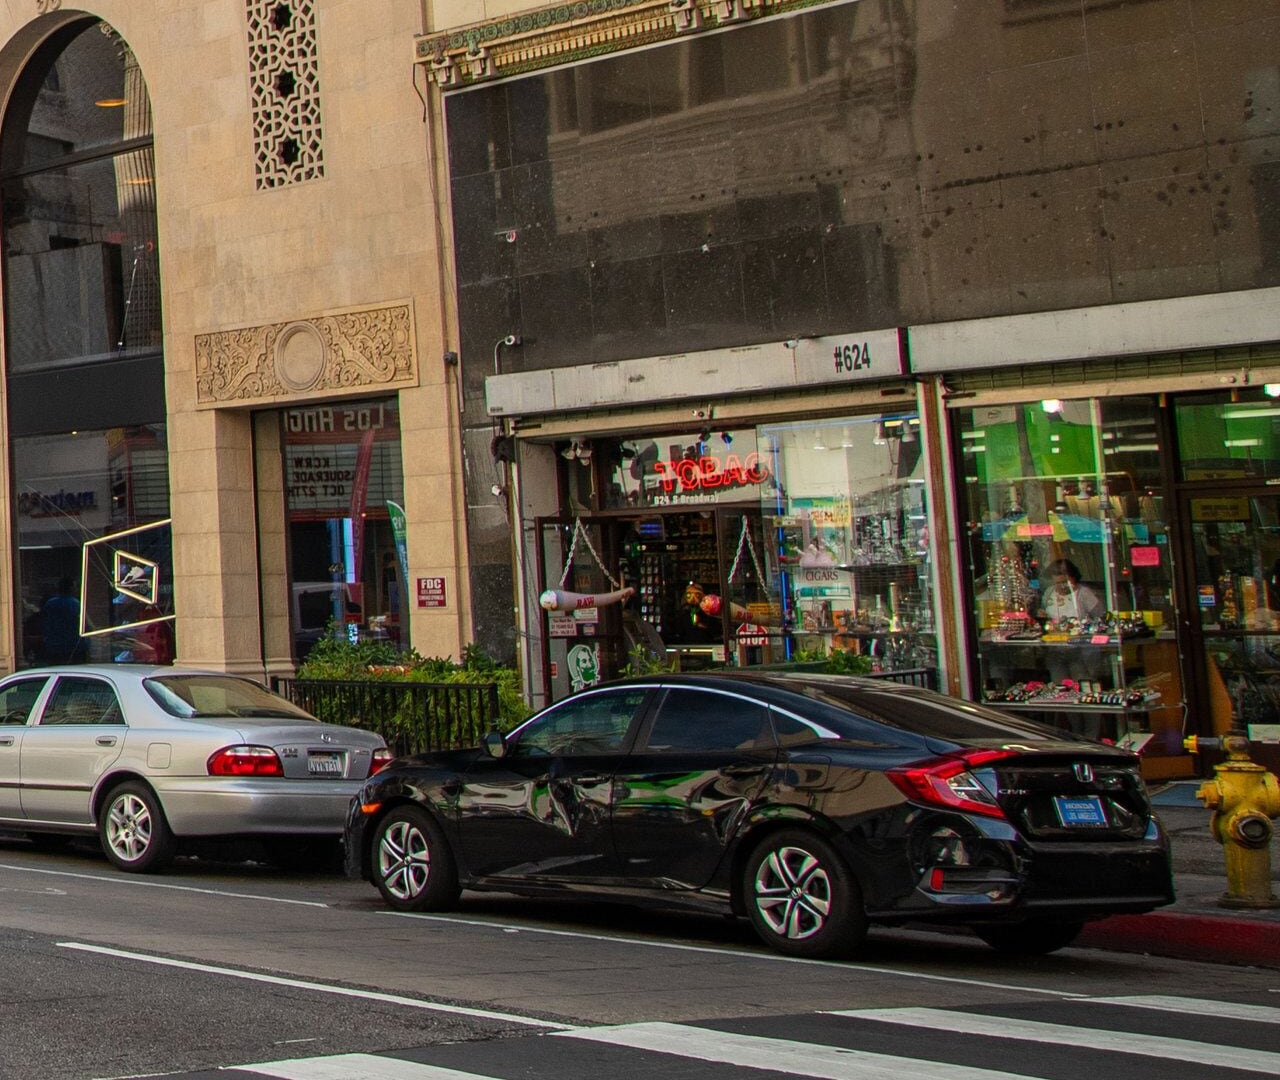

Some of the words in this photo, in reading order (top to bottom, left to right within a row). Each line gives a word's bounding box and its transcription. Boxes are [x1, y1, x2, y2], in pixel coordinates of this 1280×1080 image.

[833, 342, 871, 374] #624
[653, 496, 670, 506] 624
[680, 493, 719, 504] Broadway
[805, 570, 839, 582] CIGARS
[421, 578, 442, 589] FDC
[576, 596, 595, 609] RAW
